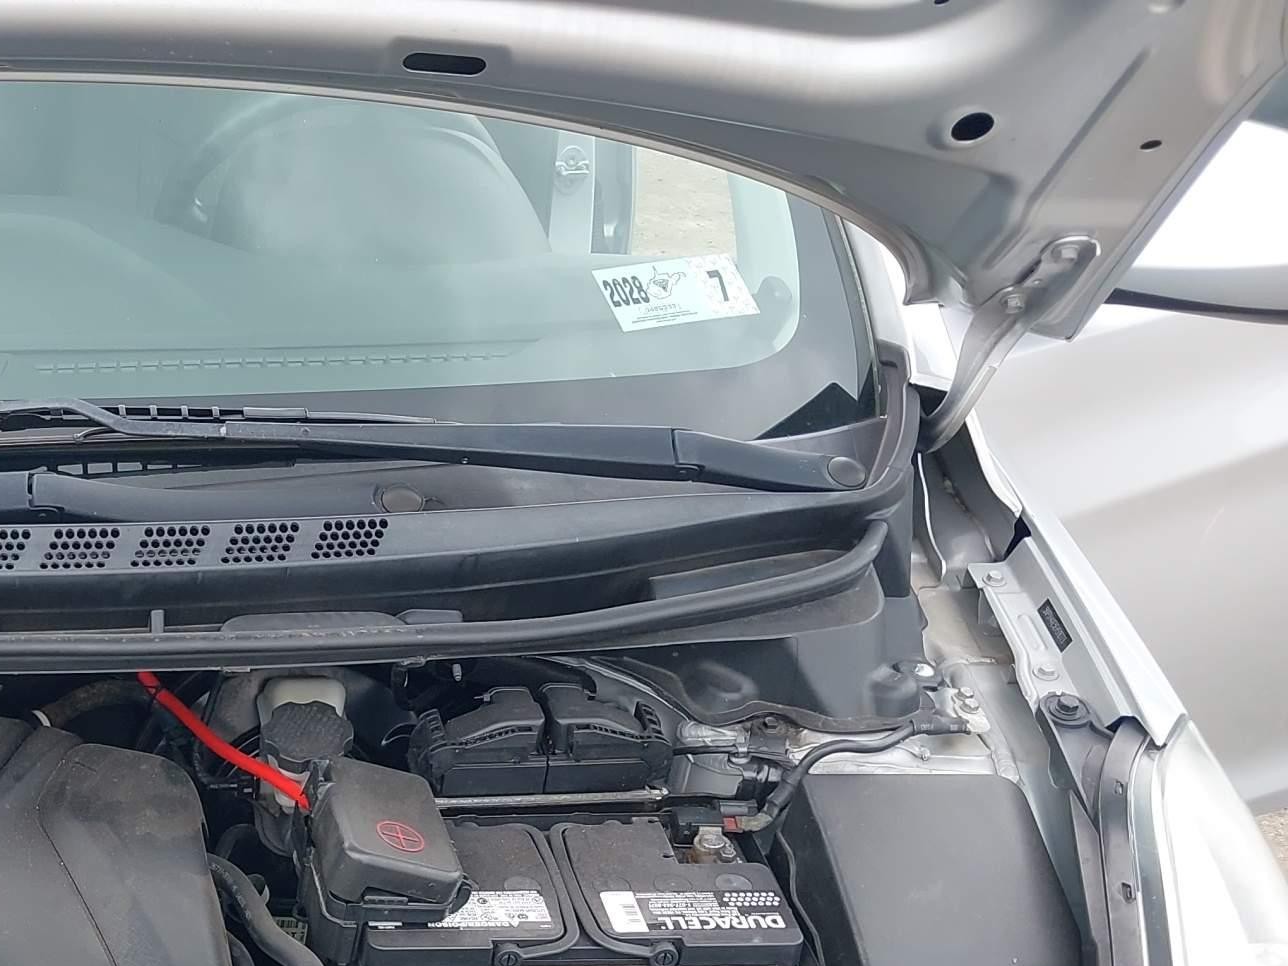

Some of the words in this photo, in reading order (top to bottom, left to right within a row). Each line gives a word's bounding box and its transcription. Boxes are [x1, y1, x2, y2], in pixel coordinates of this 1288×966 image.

[603, 276, 650, 307] 2028
[706, 270, 729, 301] 7
[657, 915, 787, 930] DURACELL
